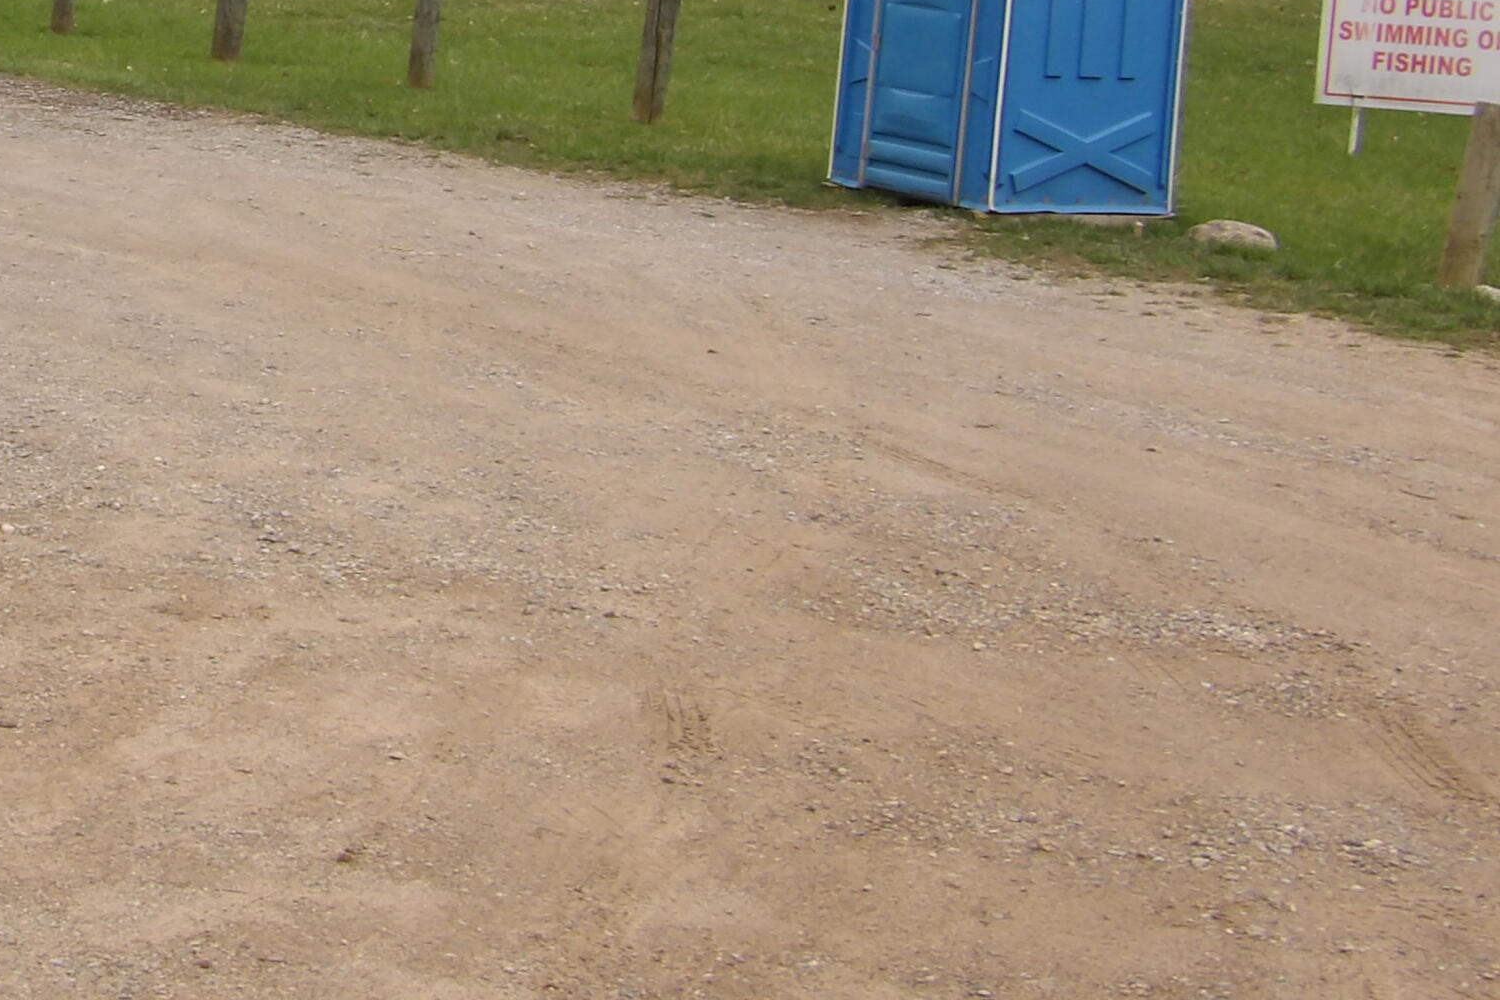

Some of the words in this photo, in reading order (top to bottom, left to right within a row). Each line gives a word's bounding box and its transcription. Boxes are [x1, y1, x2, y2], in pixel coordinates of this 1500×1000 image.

[1339, 20, 1468, 48] SWIMMING
[1477, 30, 1500, 51] O
[1372, 51, 1472, 77] FISHING
